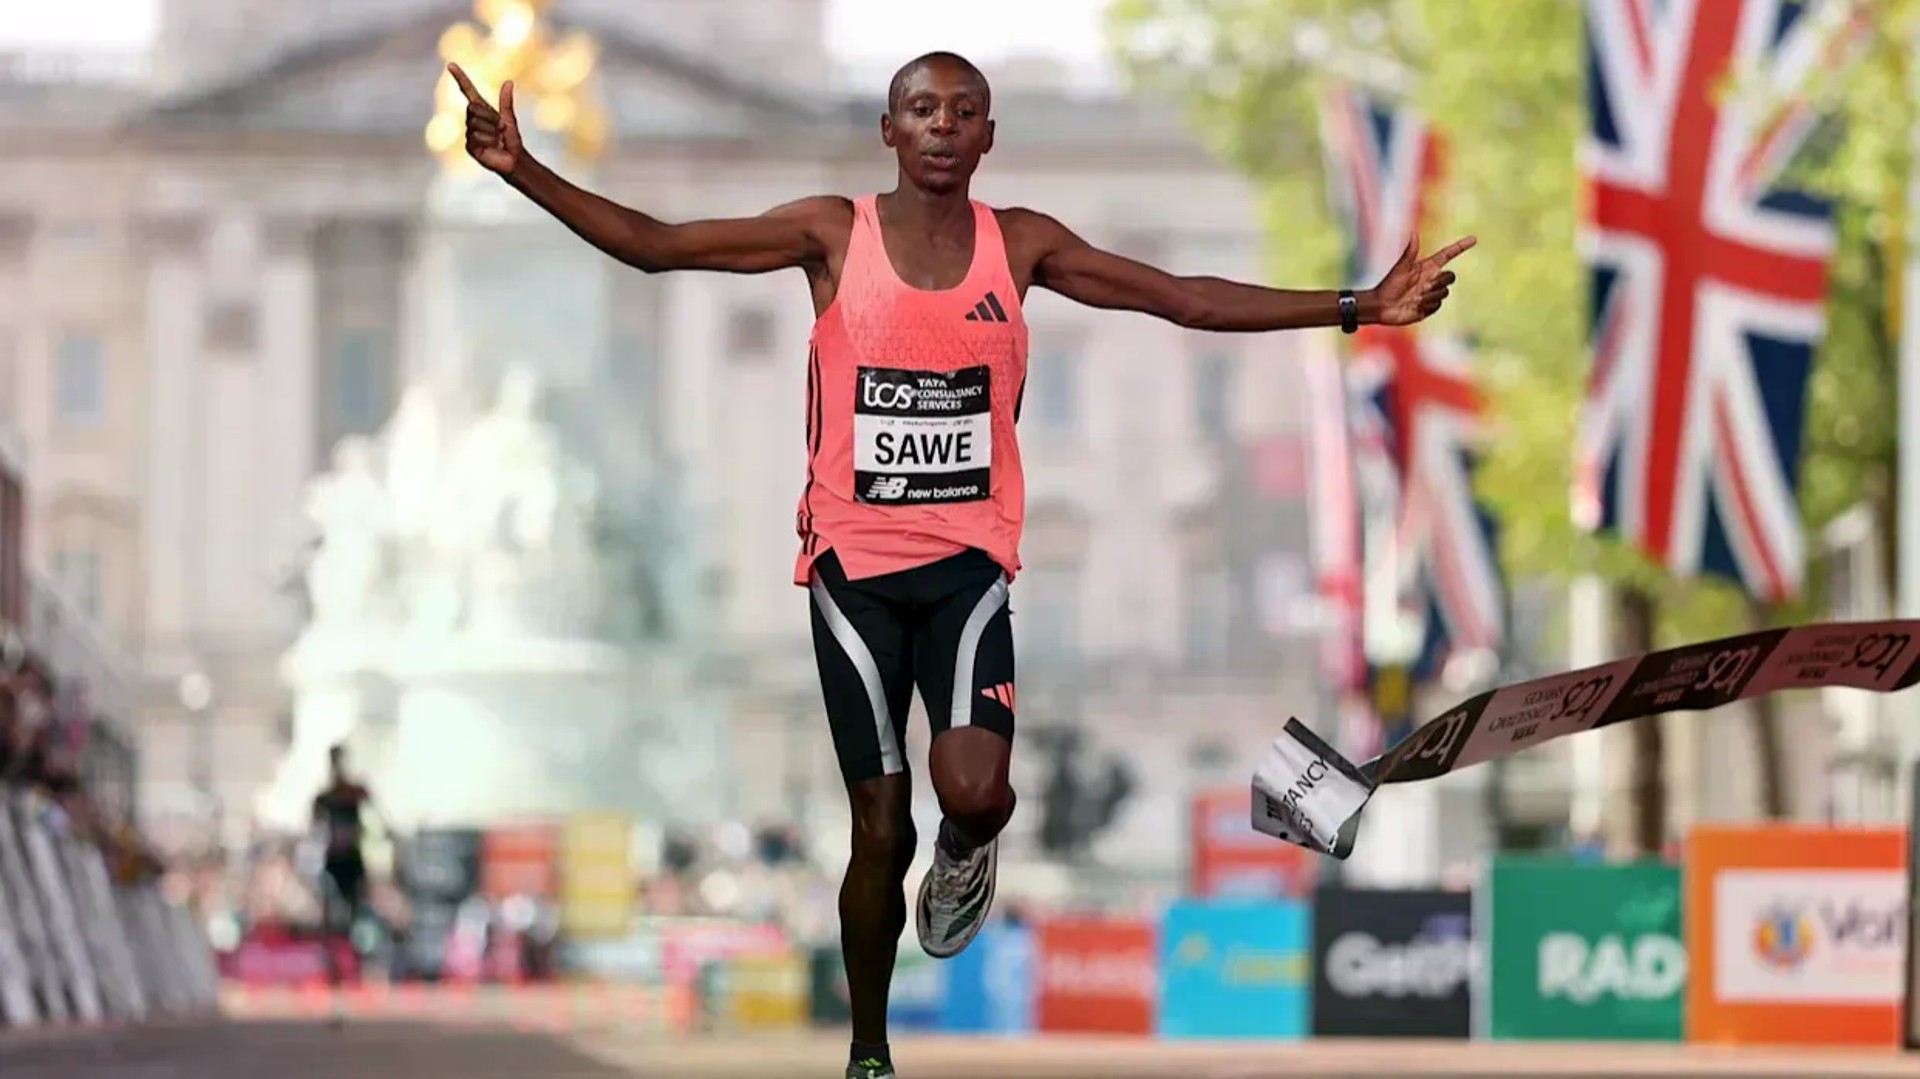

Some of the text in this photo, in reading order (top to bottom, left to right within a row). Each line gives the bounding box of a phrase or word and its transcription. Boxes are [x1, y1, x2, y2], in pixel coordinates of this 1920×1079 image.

[863, 375, 913, 409] tcs
[917, 379, 948, 388] TATA
[917, 386, 983, 399] CONSULTANCY
[916, 400, 962, 410] SERVICES
[874, 431, 973, 466] SAWE
[908, 485, 979, 499] new balance
[1694, 645, 1760, 695] tcs
[1550, 674, 1614, 724] tcs
